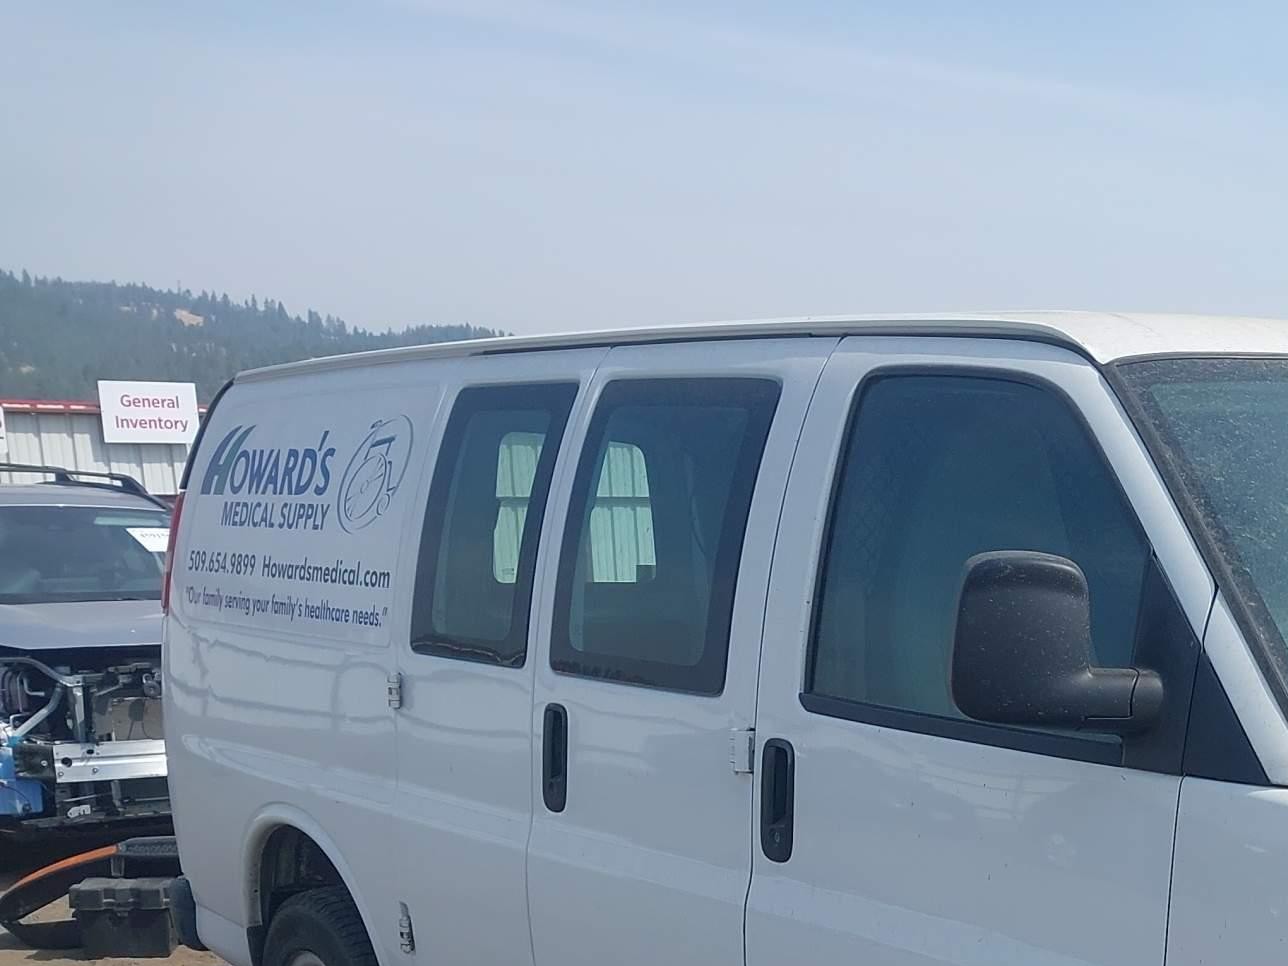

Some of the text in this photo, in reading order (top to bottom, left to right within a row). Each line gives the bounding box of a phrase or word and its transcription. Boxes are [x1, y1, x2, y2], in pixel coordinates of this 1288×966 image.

[120, 394, 179, 409] General
[115, 415, 188, 433] Inventory
[200, 424, 336, 496] HOWARD'S
[220, 501, 331, 530] MEDICAL SUPPLY
[188, 550, 391, 588] 509.654.9899 Howardsmedical.com
[224, 591, 250, 615] serving
[252, 599, 269, 616] your
[271, 593, 303, 622] family's
[304, 598, 350, 623] healthcare
